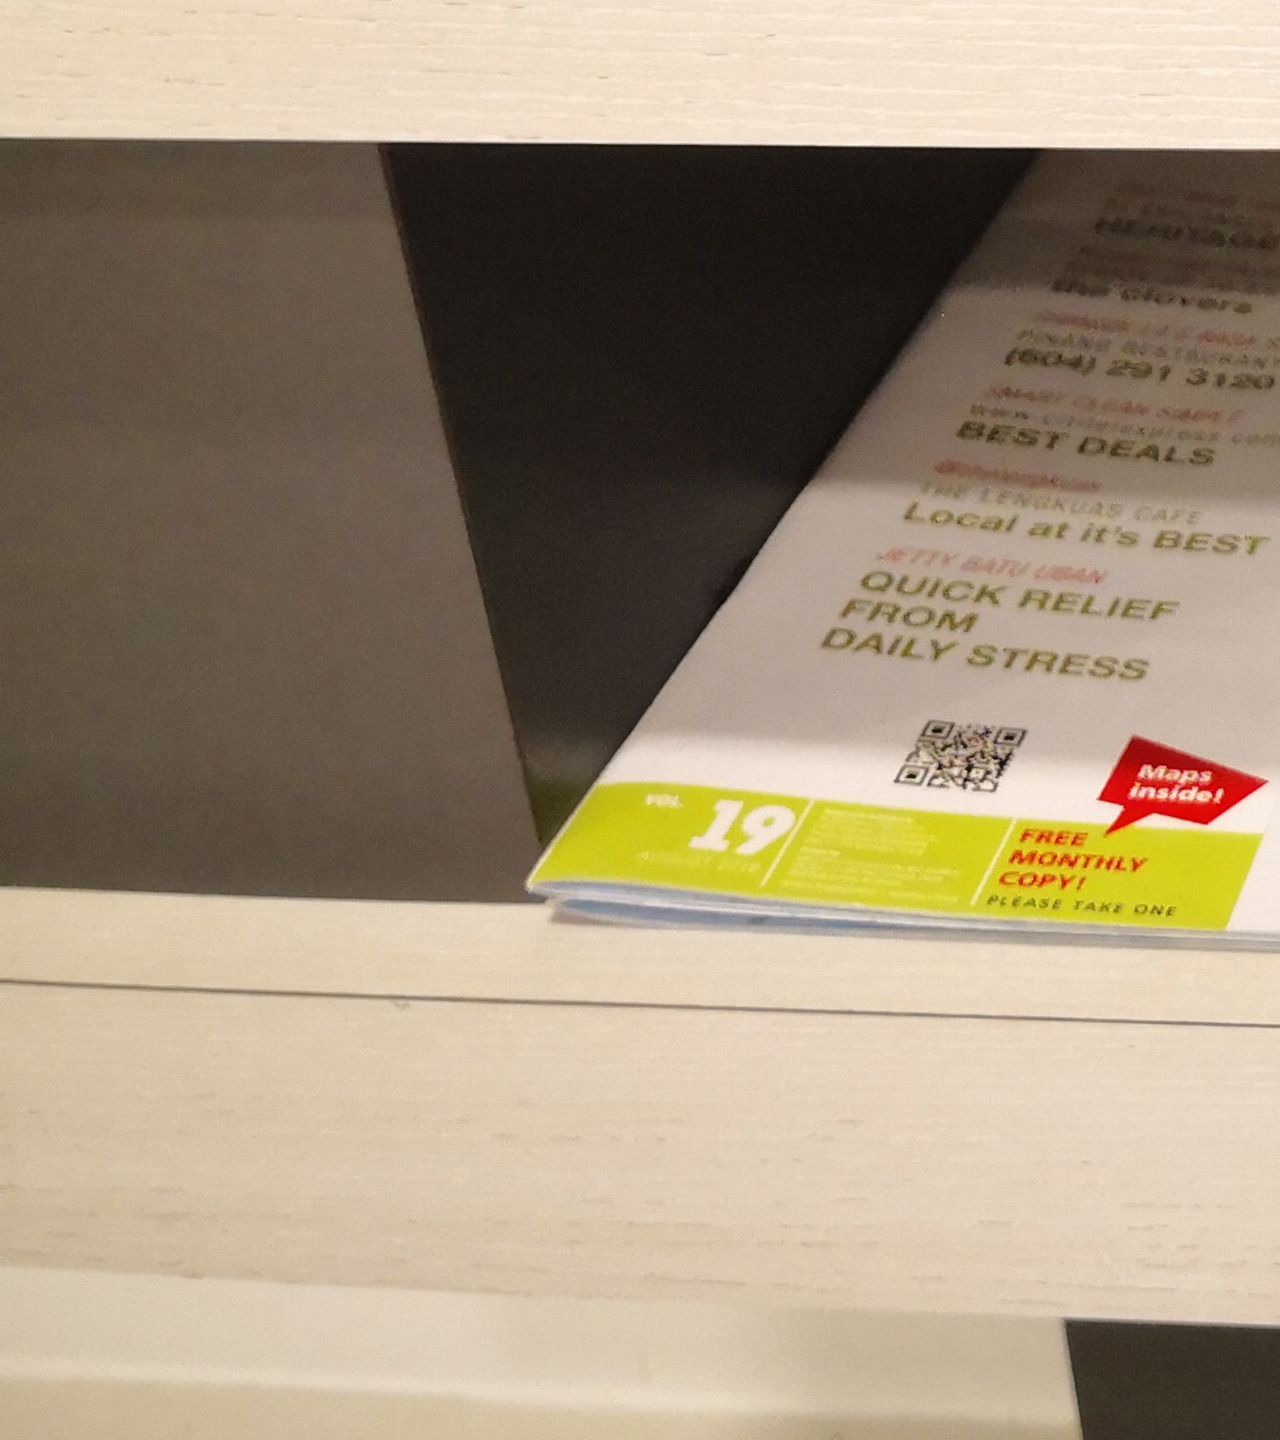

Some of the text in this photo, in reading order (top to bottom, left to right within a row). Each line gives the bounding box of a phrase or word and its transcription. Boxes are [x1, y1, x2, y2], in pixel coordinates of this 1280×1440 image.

[957, 421, 1072, 450] BEST
[1078, 437, 1216, 466] DEALS
[904, 502, 1271, 556] Local at it's BEST
[861, 571, 1180, 621] QUICK RELIEF
[841, 599, 979, 633] FROM
[821, 627, 1150, 682] DAILY STRESS
[1137, 762, 1214, 786] Maps
[1128, 780, 1225, 806] inside!
[688, 799, 798, 857] 19
[1018, 827, 1087, 848] FREE
[1008, 848, 1149, 873] MONTHLY
[998, 870, 1087, 892] COPY!
[985, 894, 1178, 917] PLEASE TAKE ONE
